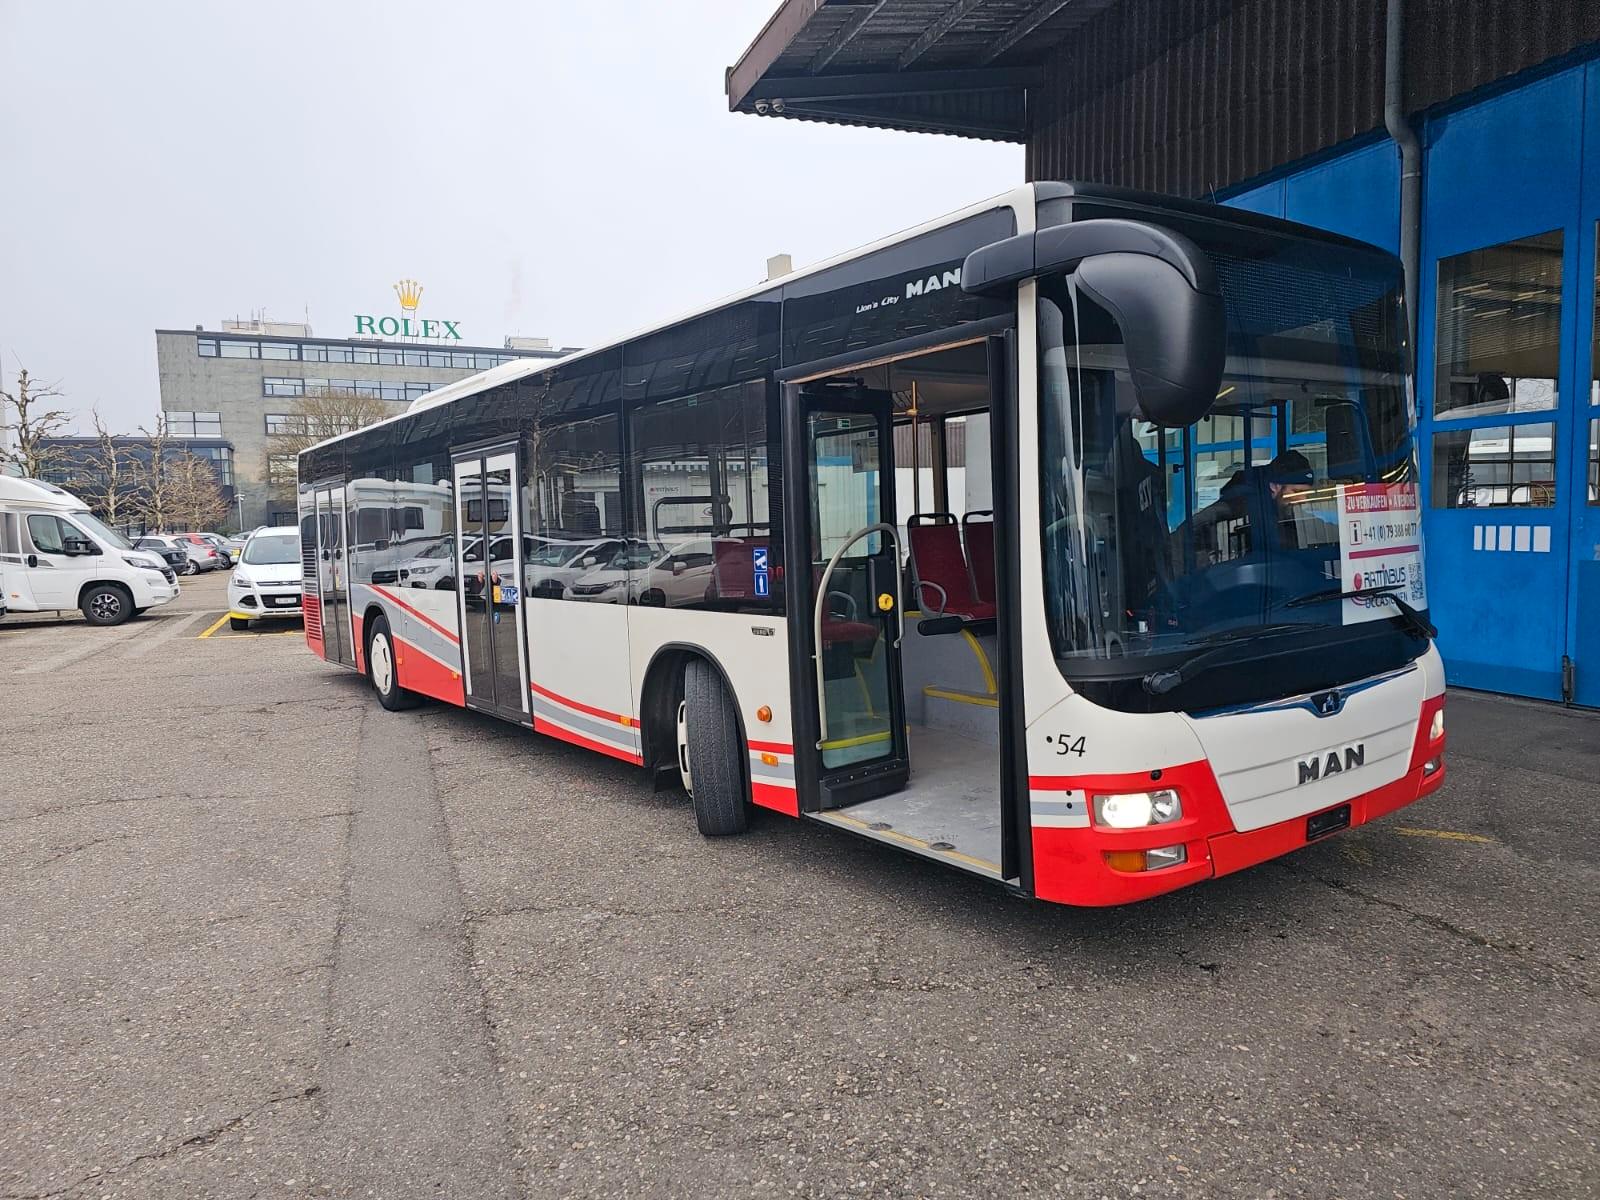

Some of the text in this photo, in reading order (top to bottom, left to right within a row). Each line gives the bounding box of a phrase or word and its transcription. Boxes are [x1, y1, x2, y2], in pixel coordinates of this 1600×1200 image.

[856, 268, 961, 313] Lion's City MAN
[354, 314, 463, 340] ROLEX
[1057, 734, 1086, 757] 54
[1298, 743, 1365, 785] MAN
